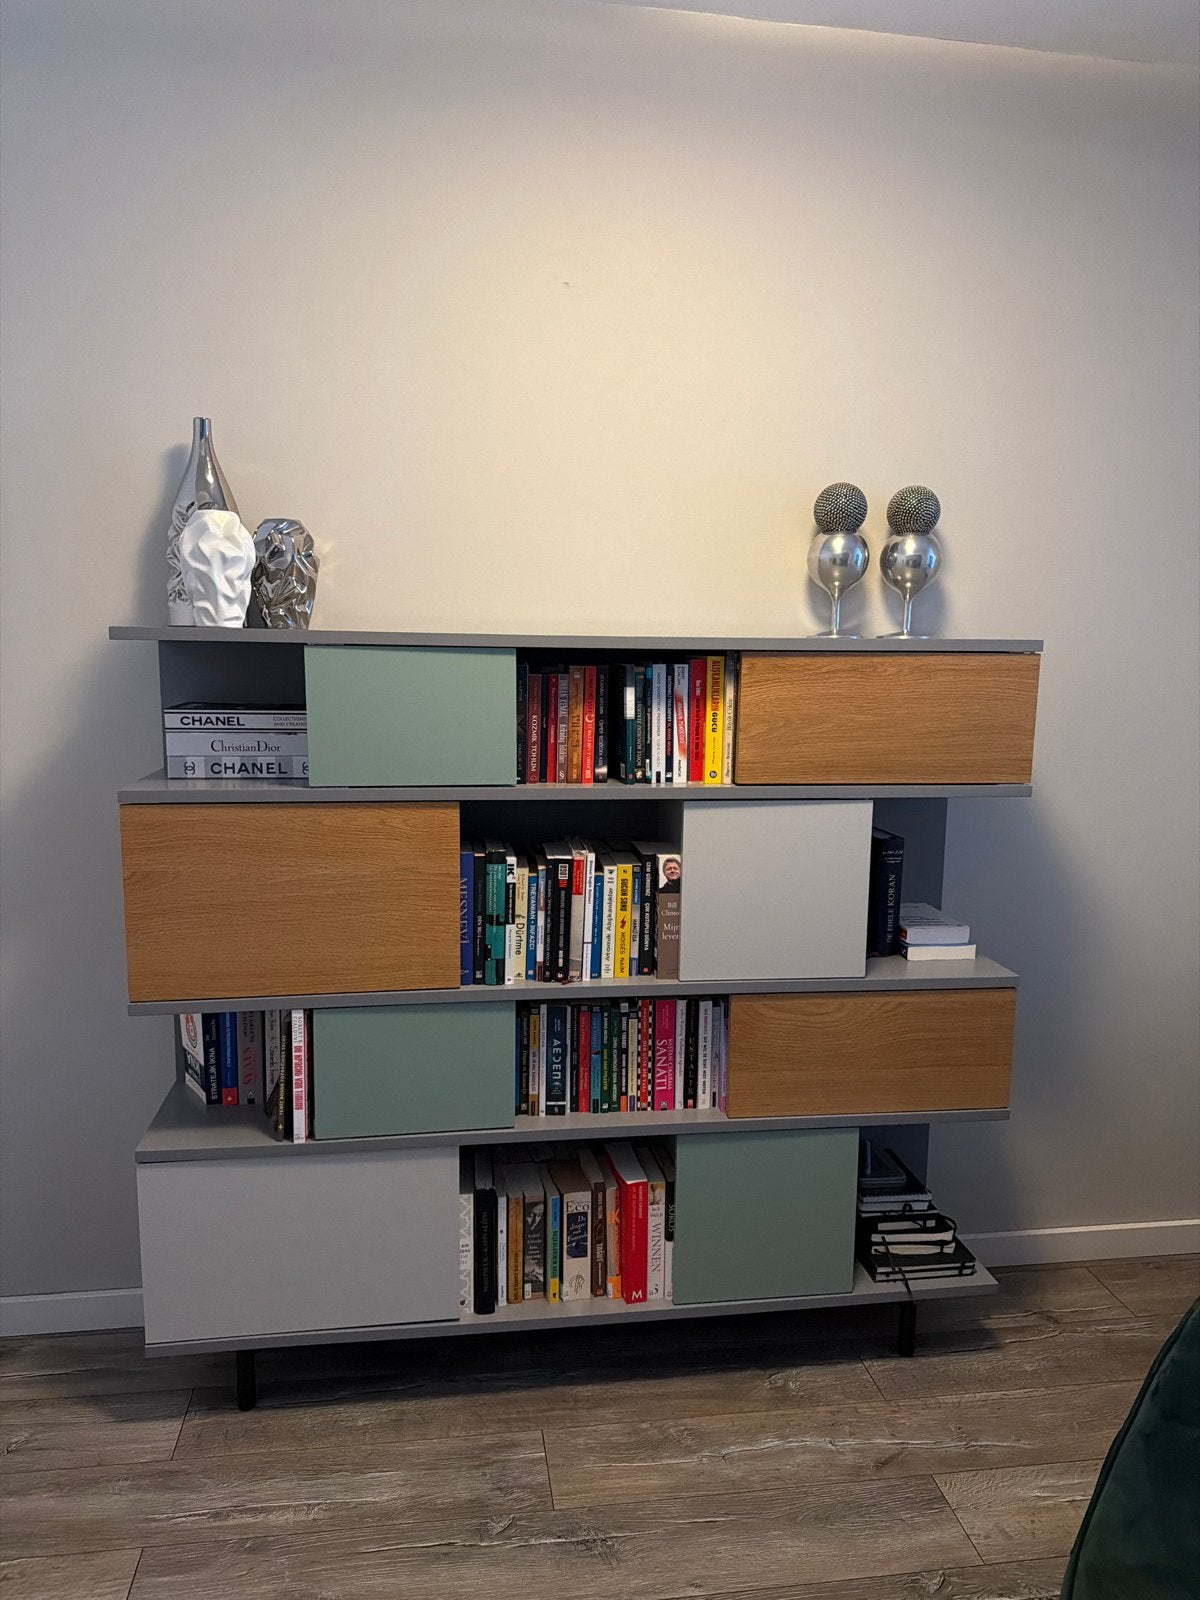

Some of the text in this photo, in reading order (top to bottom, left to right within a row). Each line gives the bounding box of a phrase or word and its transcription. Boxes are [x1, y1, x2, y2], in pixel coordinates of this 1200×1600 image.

[559, 699, 567, 717] KEMAL
[180, 716, 246, 726] CHANEL
[210, 762, 288, 775] CHANEL
[605, 887, 614, 931] Alışkanlıklar
[620, 897, 628, 912] SONU
[886, 874, 896, 943] DE EDELE KORAN
[515, 922, 525, 955] Dürtme
[208, 1047, 216, 1065] İKNA
[655, 1039, 668, 1092] SANATI
[209, 1064, 219, 1100] STRATEJİK
[566, 1200, 590, 1213] Eco
[651, 1222, 662, 1273] WINNEN
